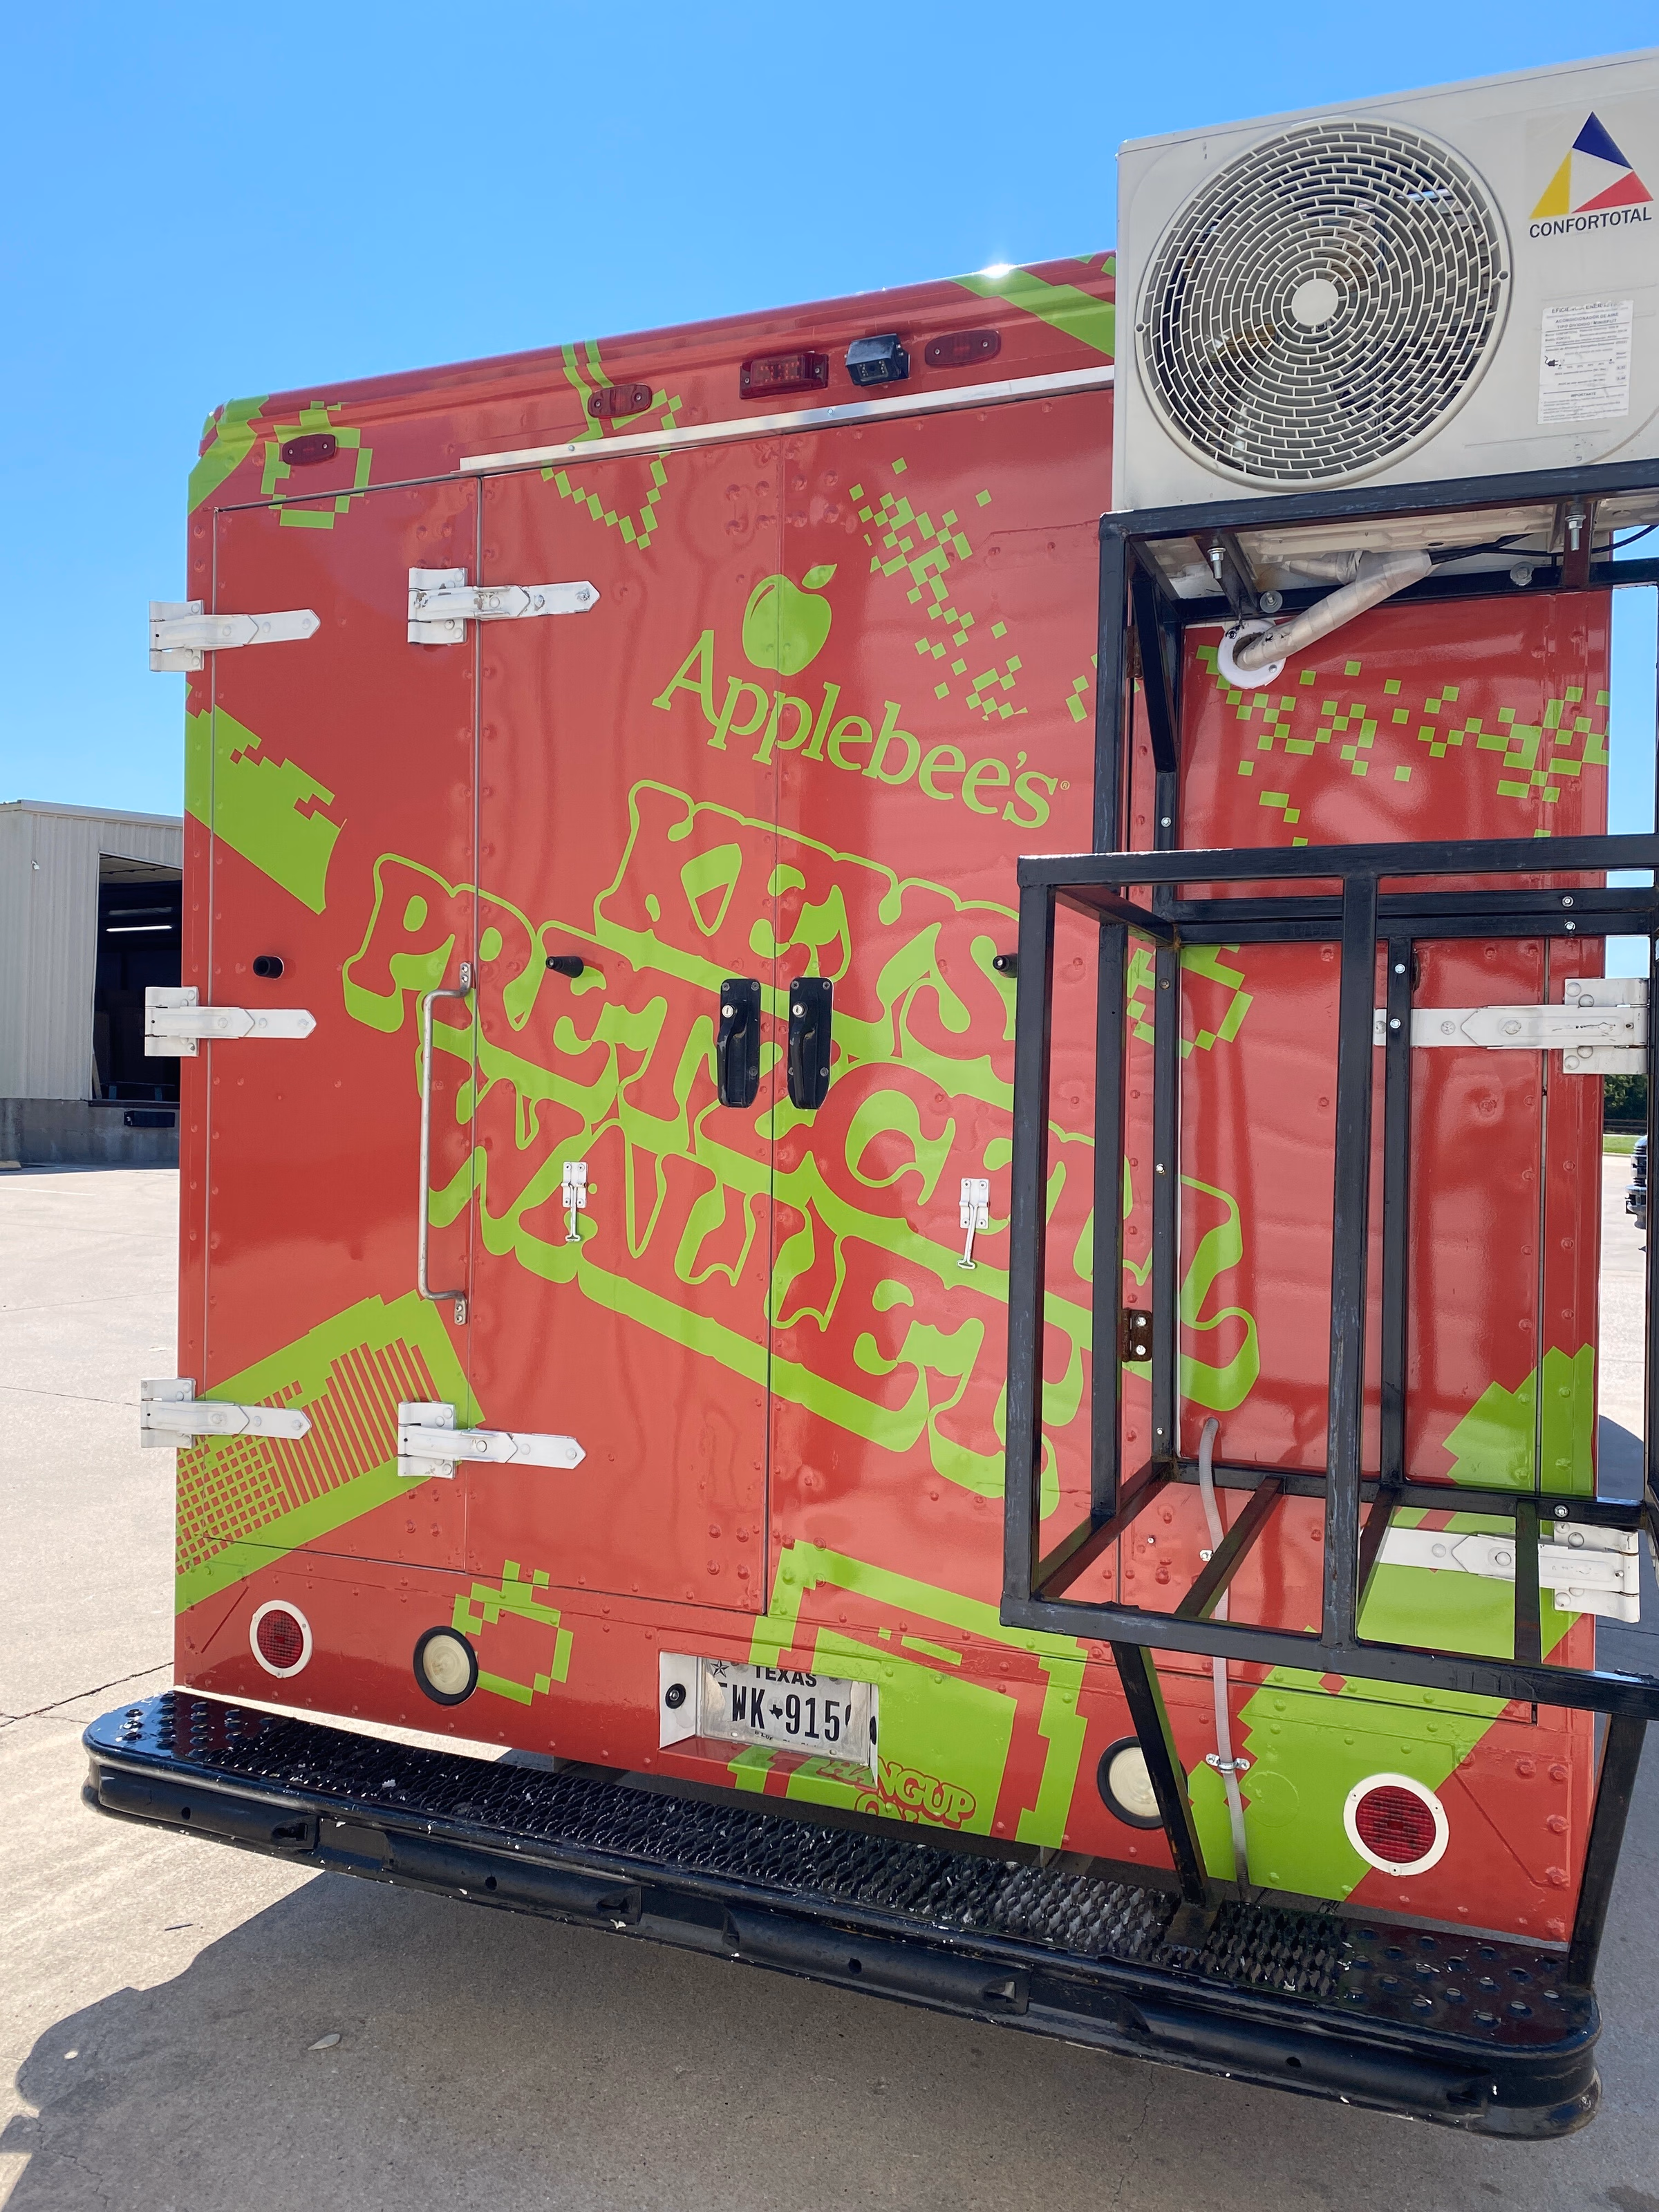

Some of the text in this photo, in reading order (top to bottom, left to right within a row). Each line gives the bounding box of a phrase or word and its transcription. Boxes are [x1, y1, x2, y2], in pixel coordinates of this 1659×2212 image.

[1530, 207, 1652, 238] CONFORTOTAL
[651, 629, 1058, 829] Applebee's
[593, 779, 1022, 1099] KEYS
[752, 1664, 817, 1687] TEXAS
